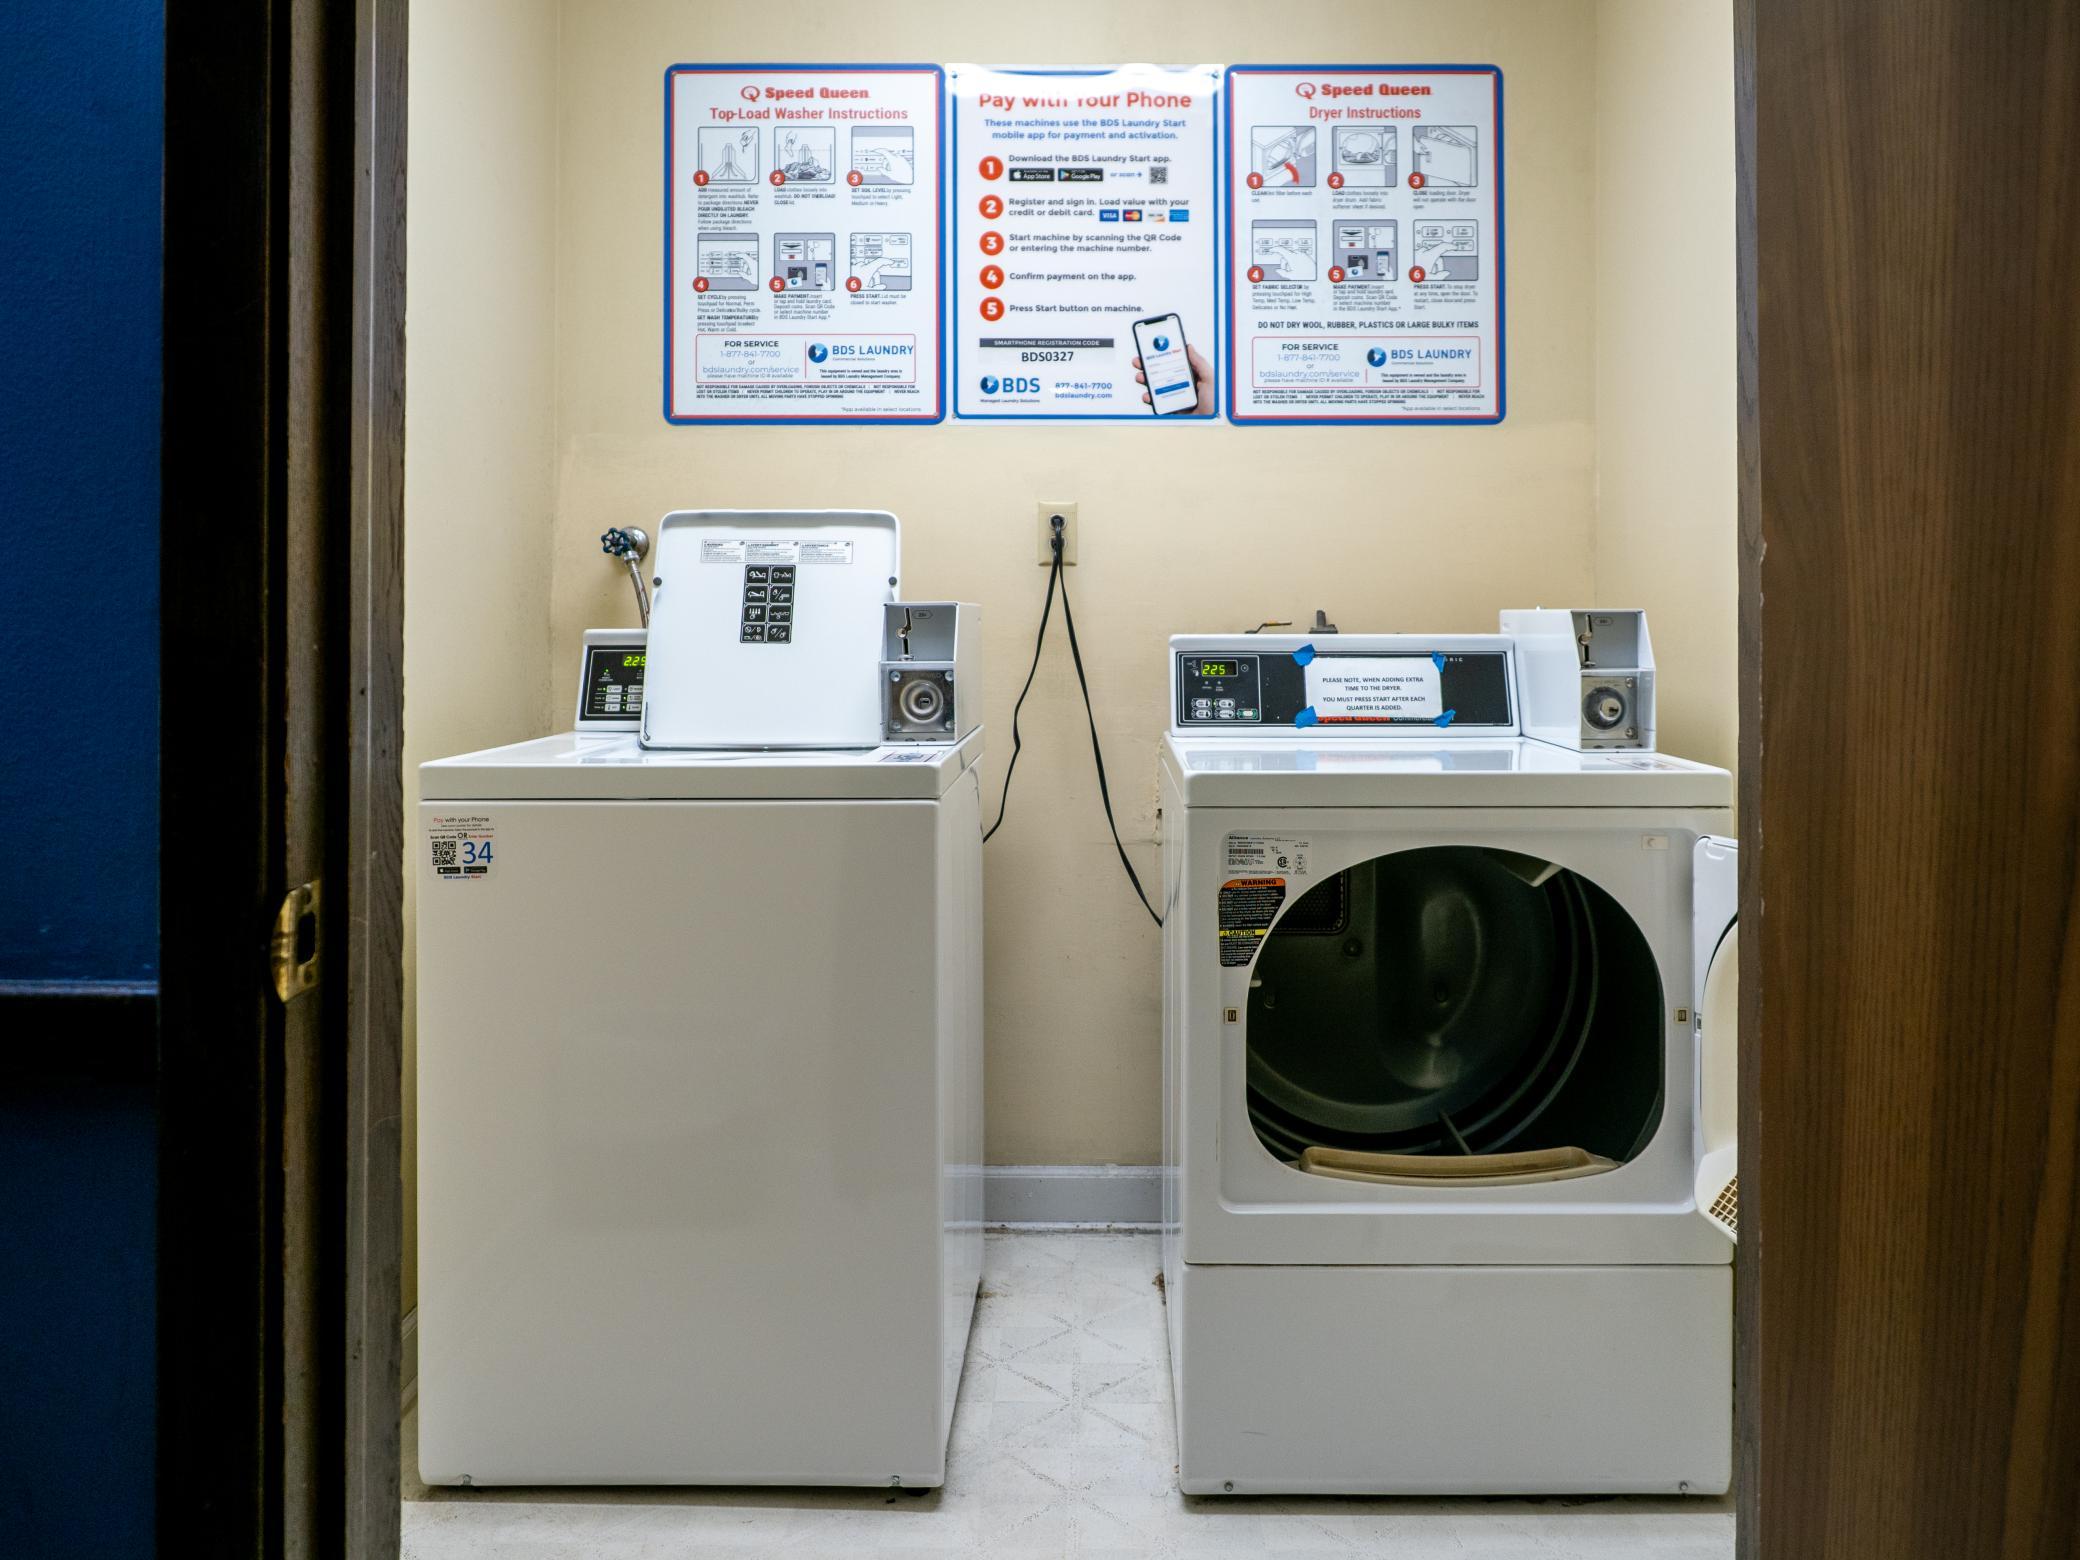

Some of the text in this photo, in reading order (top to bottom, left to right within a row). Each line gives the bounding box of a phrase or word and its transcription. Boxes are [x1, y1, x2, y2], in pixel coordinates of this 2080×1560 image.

[765, 87, 869, 101] Speed Queen
[1321, 84, 1430, 98] Speed Queen
[980, 93, 1015, 111] Pay
[1126, 92, 1192, 108] Phone
[710, 107, 908, 122] Top-Load Washer Instructions
[1309, 106, 1421, 121] Dryer Instructions
[985, 119, 1012, 127] These
[1015, 119, 1060, 127] machines
[1082, 119, 1097, 127] the
[1100, 119, 1119, 127] BDS
[1122, 119, 1160, 129] Laundry
[1163, 119, 1186, 127] Start
[1064, 131, 1105, 140] payment
[1092, 155, 1126, 163] Laundry
[1009, 198, 1045, 206] Register
[1066, 198, 1084, 206] sign
[1073, 234, 1082, 242] by
[1086, 234, 1124, 242] scanning
[1021, 244, 1058, 253] entering
[1047, 273, 1085, 281] payment
[1010, 305, 1033, 313] Press
[1036, 305, 1056, 313] Start
[1059, 305, 1088, 313] button
[1104, 305, 1144, 313] machine.
[1258, 321, 1479, 329] DO NOT DRY WOOL, RUBBER, PLASTICS OR LARGE BULKY ITEMS
[720, 350, 780, 358] 1-877-841-7700
[833, 346, 913, 355] BDS LAUNDRY
[1391, 350, 1471, 359] BDS LAUNDRY
[1021, 351, 1074, 362] BDS0327
[1260, 370, 1360, 378] bdslaundry.com/service
[1002, 378, 1040, 393] BDS
